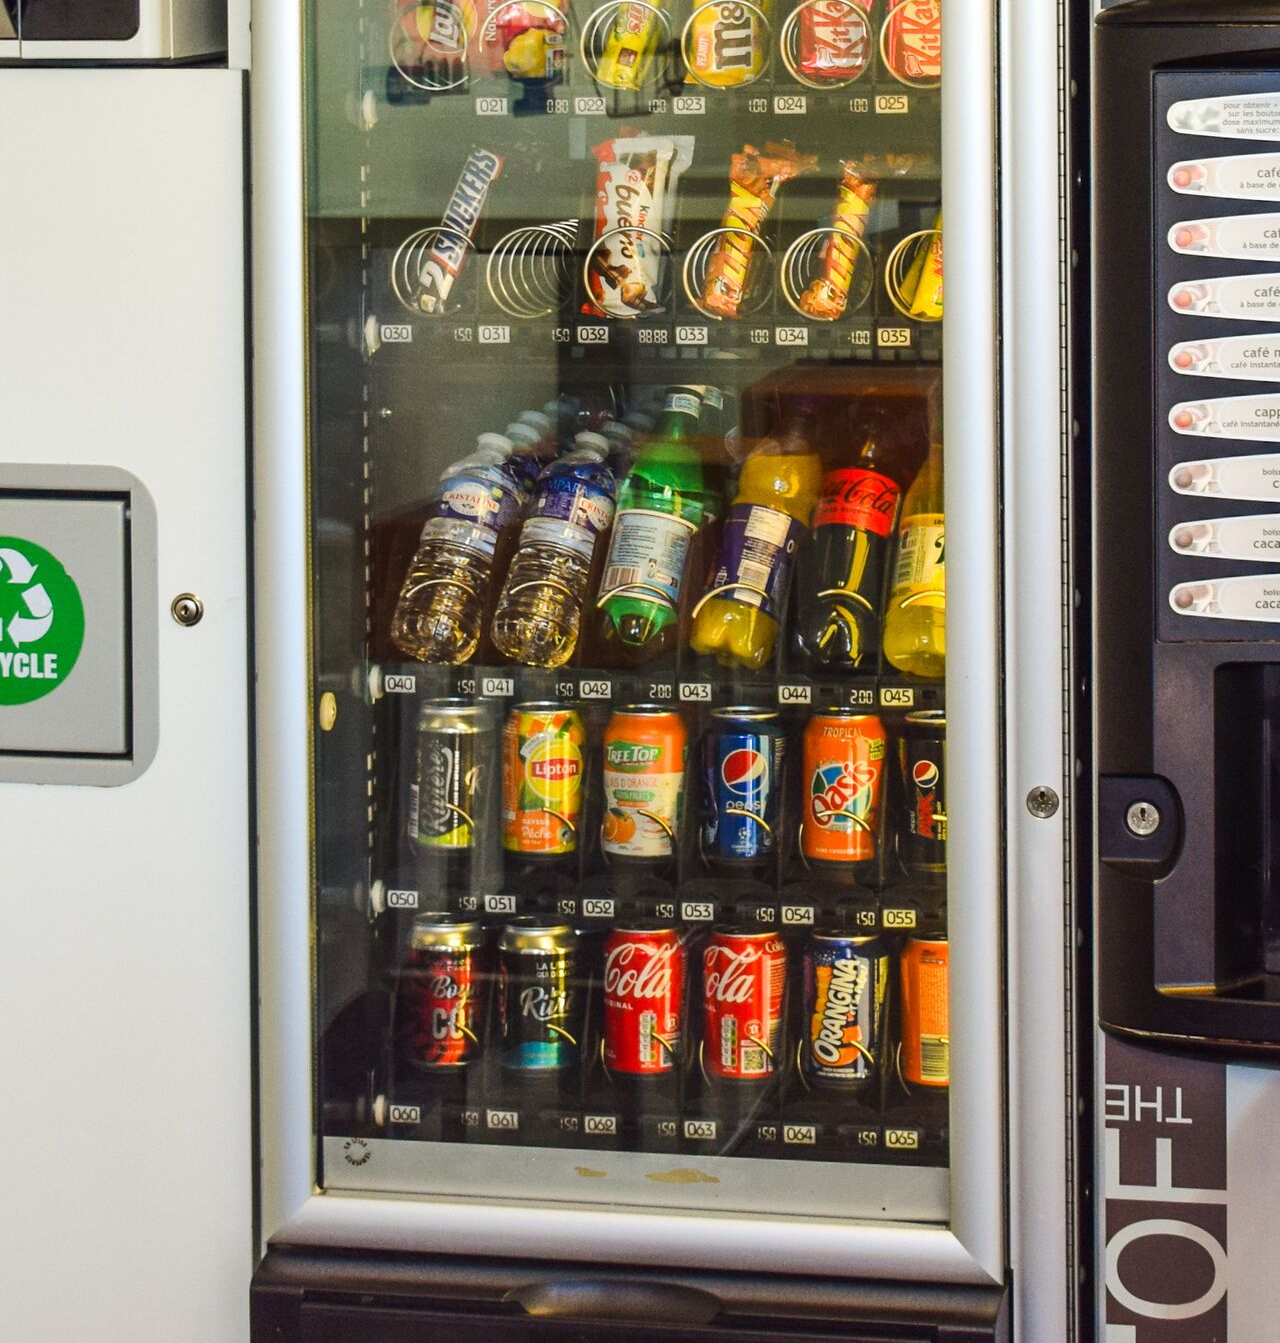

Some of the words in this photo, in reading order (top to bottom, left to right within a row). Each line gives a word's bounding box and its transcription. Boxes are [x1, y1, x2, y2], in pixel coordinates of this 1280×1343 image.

[480, 99, 505, 113] 021
[577, 98, 604, 113] 022
[675, 97, 703, 112] 023
[776, 97, 804, 111] 024
[877, 96, 906, 111] 025
[1246, 181, 1265, 189] base
[1267, 181, 1277, 189] de
[436, 150, 497, 261] SNICKERS
[1254, 286, 1280, 298] café
[384, 327, 410, 341] 030
[482, 328, 506, 342] 031
[579, 328, 607, 342] 032
[679, 328, 706, 342] 033
[778, 329, 806, 343] 034
[880, 329, 909, 343] 035
[1242, 346, 1270, 359] café
[387, 677, 413, 690] 040
[485, 680, 511, 694] 041
[582, 682, 609, 696] 042
[682, 685, 710, 698] 043
[781, 687, 809, 701] 044
[883, 689, 911, 703] 045
[607, 746, 630, 763] TREE
[631, 745, 658, 762] TOP
[535, 763, 576, 776] Lipton
[389, 892, 416, 906] 050
[488, 896, 513, 911] 051
[585, 901, 613, 914] 052
[684, 904, 712, 918] 053
[784, 908, 811, 922] 054
[886, 911, 914, 925] 055
[814, 958, 861, 1064] ORANGINA
[1105, 1083, 1193, 1124] THE
[392, 1108, 418, 1121] 060
[490, 1113, 516, 1127] 061
[587, 1119, 615, 1132] 062
[687, 1122, 714, 1136] 063
[786, 1127, 813, 1141] 064
[888, 1131, 916, 1146] 065
[1105, 1127, 1228, 1320] OF
